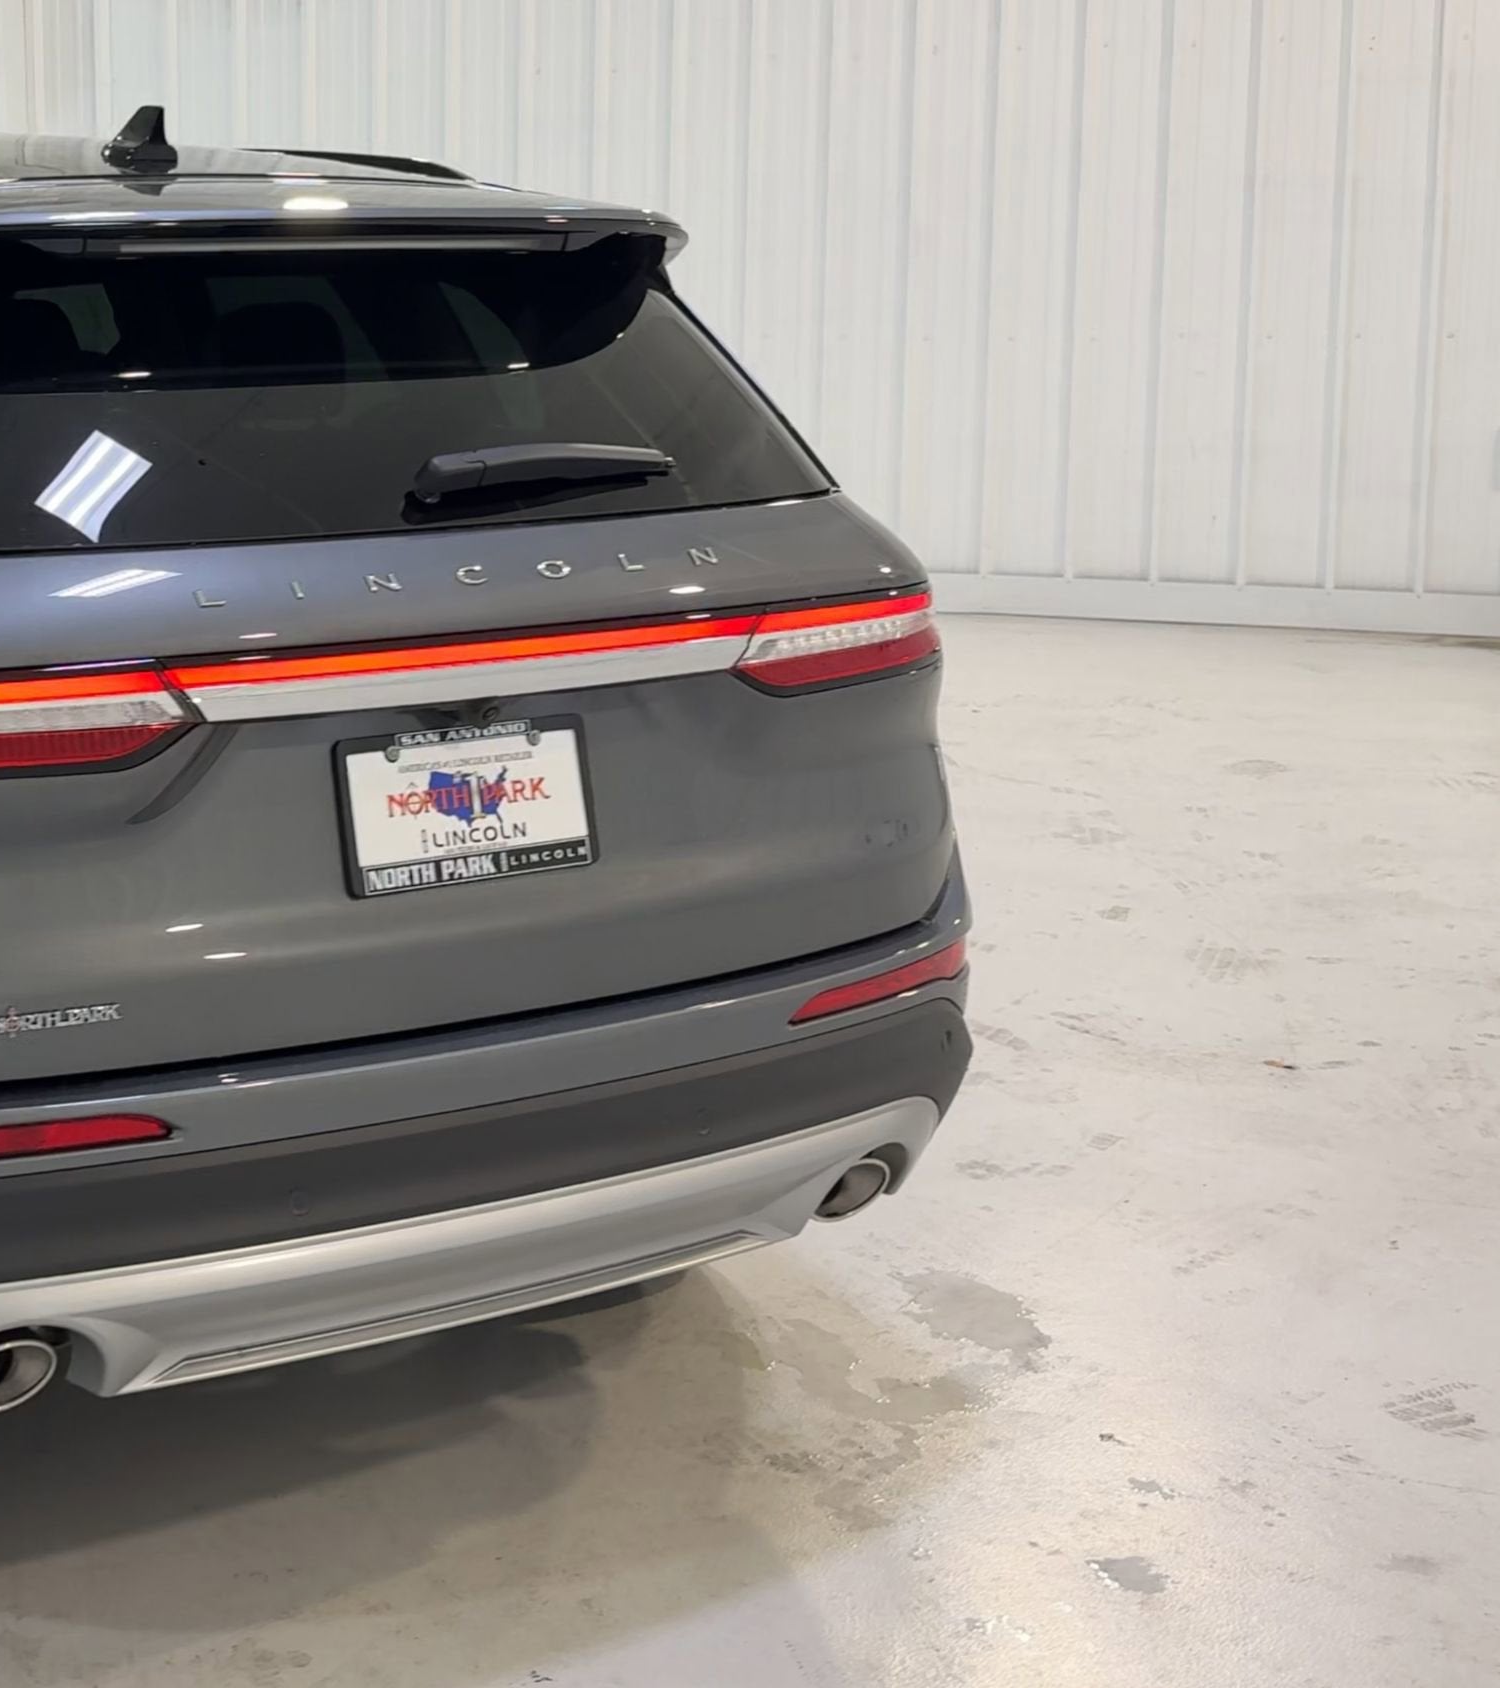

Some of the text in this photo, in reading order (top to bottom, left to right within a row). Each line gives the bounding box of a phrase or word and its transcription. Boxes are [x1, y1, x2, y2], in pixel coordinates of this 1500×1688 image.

[195, 546, 719, 608] LINCOLN
[400, 723, 527, 746] SAN ANTONIO
[386, 777, 551, 818] NORTH PARK
[432, 823, 527, 848] LINCOLN
[368, 864, 437, 891] NORTH
[441, 854, 497, 881] PARK
[510, 846, 587, 866] LINCOLN
